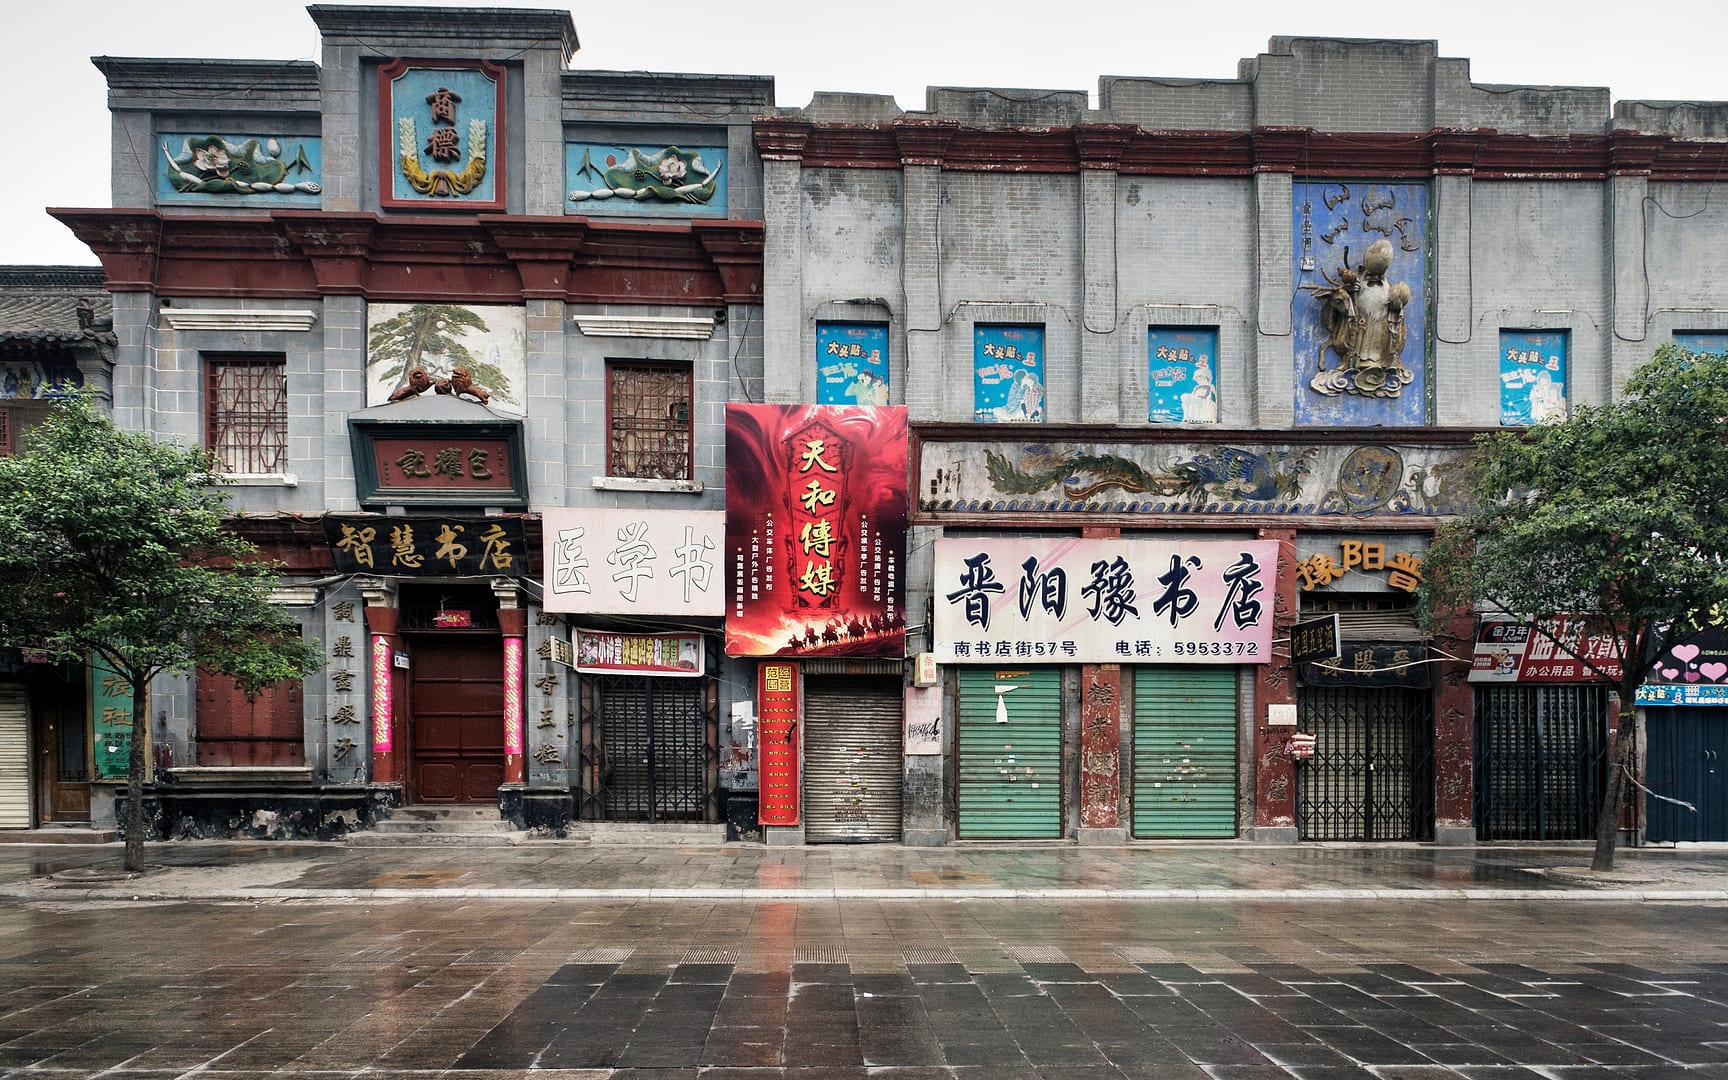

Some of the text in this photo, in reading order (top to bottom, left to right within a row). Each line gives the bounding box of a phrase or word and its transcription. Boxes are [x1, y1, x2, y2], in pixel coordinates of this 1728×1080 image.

[424, 87, 462, 163] 商標
[336, 523, 514, 570] 智慧书店
[552, 520, 716, 603] 医学书
[946, 552, 1264, 632] 晋阳豫书店
[1492, 625, 1528, 637] 金万年
[954, 640, 1078, 657] 南书店街57号
[1174, 641, 1258, 656] 5953372
[1525, 665, 1575, 677] 办公用品
